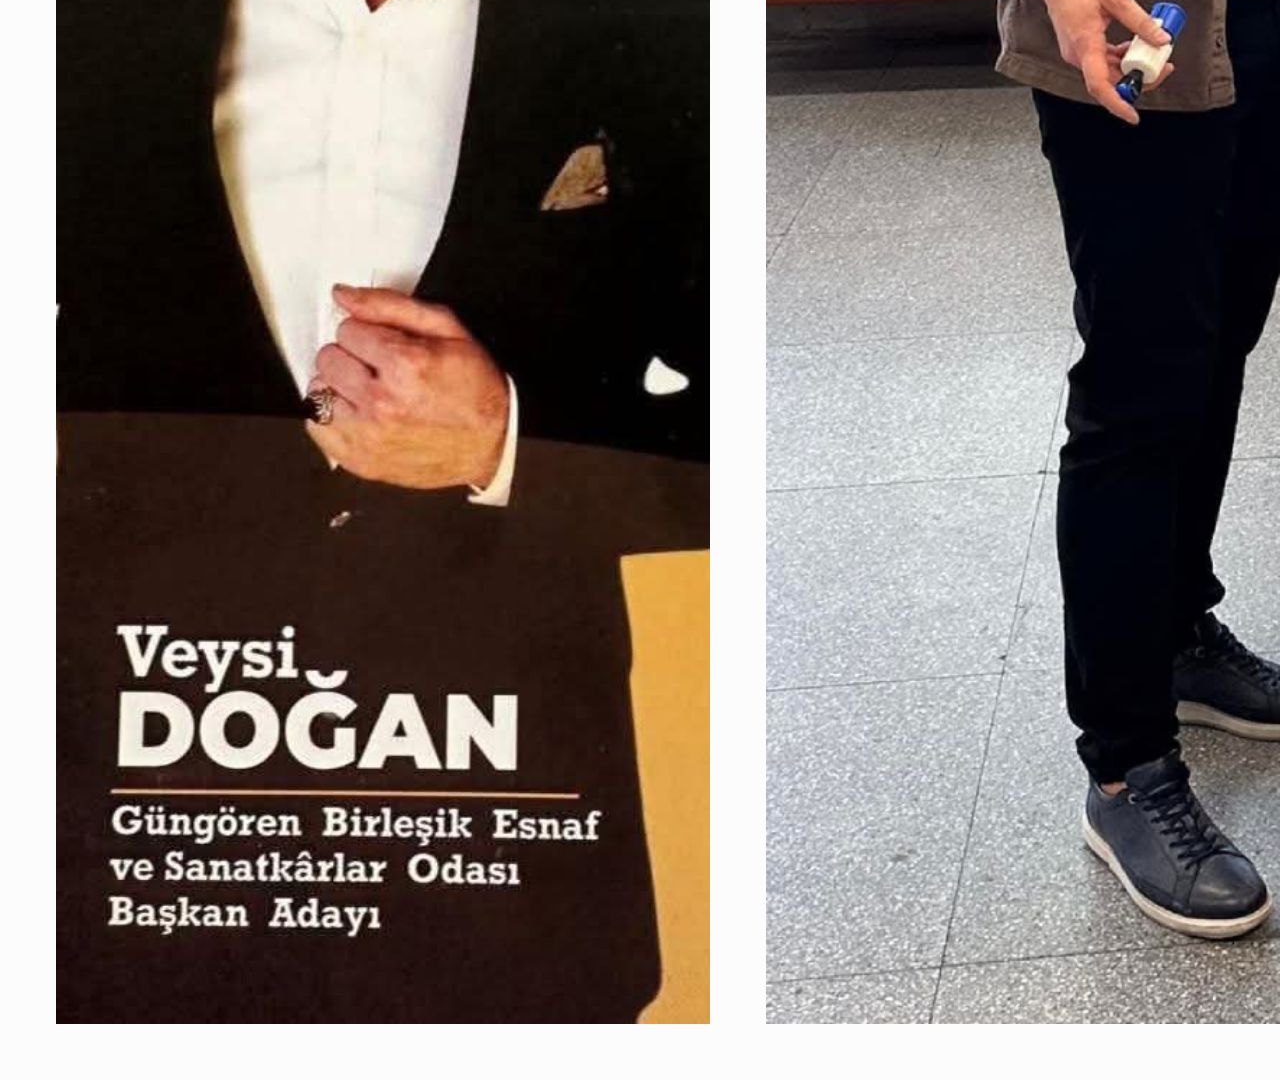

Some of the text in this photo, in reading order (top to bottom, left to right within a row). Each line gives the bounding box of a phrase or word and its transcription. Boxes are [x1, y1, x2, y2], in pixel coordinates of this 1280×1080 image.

[117, 625, 298, 693] Veysi
[117, 670, 519, 771] DOĞAN
[111, 804, 602, 846] Güngören Birleşik Esnaf
[110, 850, 521, 885] ve Sanatkârlar Odası
[108, 896, 381, 937] Başkan Adayı
